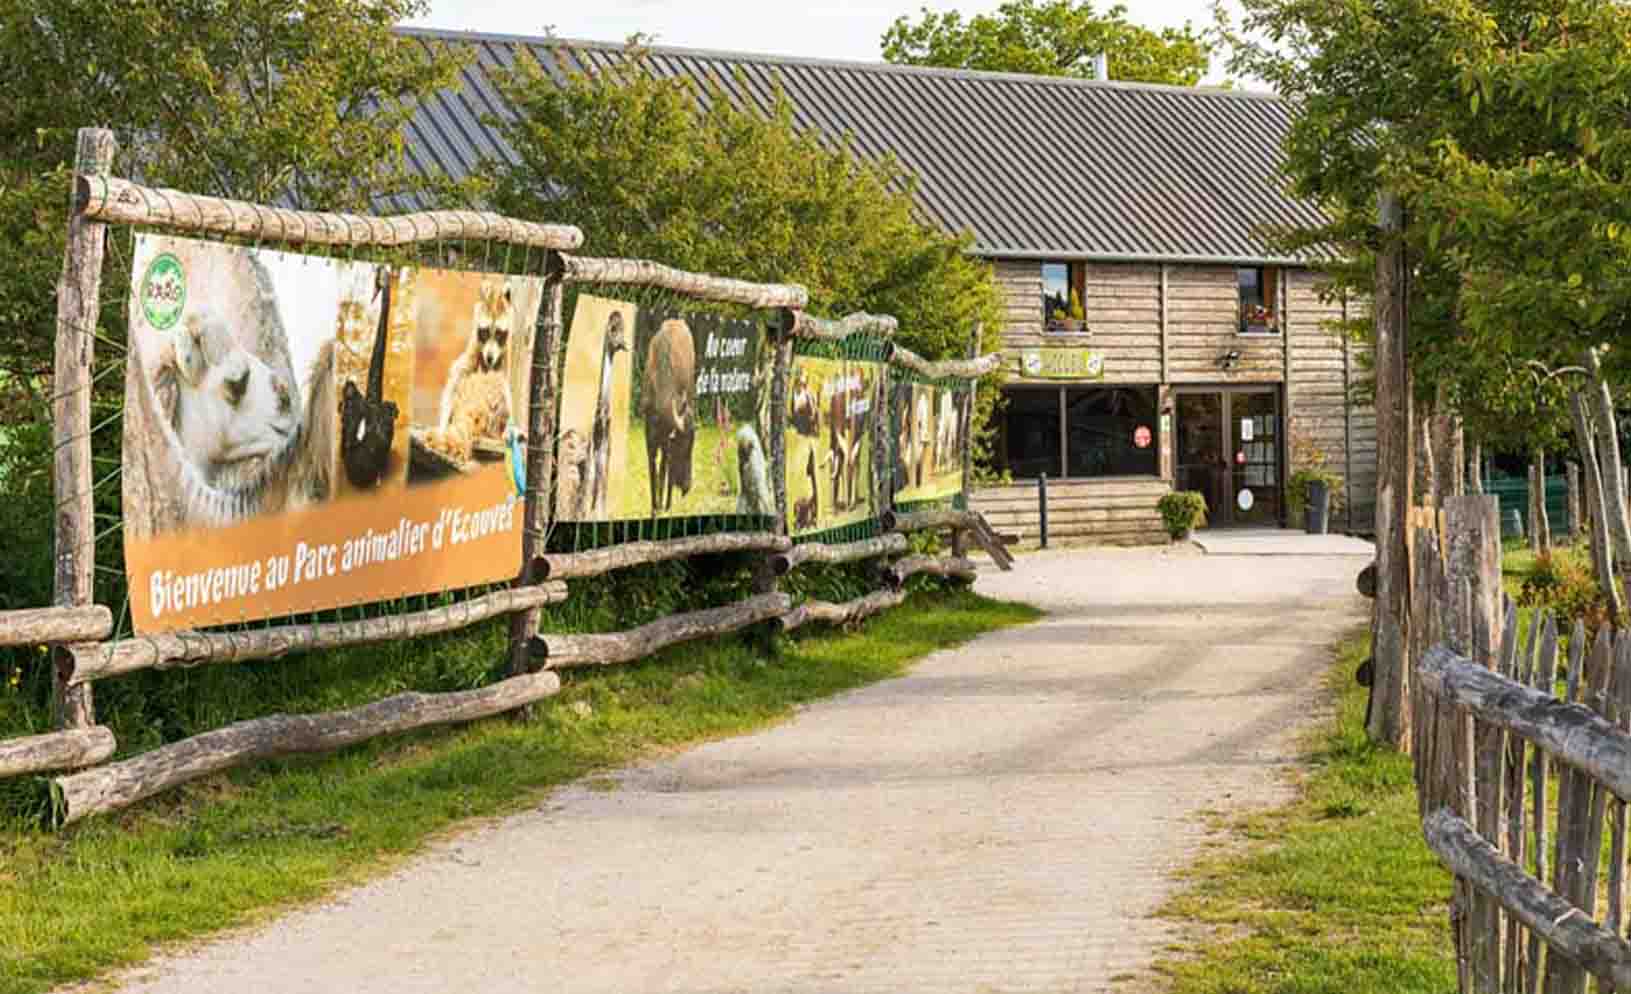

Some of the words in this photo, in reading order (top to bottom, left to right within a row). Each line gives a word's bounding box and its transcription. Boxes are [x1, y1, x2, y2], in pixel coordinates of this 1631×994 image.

[150, 559, 262, 616] Bienvenue
[266, 554, 289, 591] au
[293, 541, 337, 584] Parc
[341, 517, 430, 571] animalier
